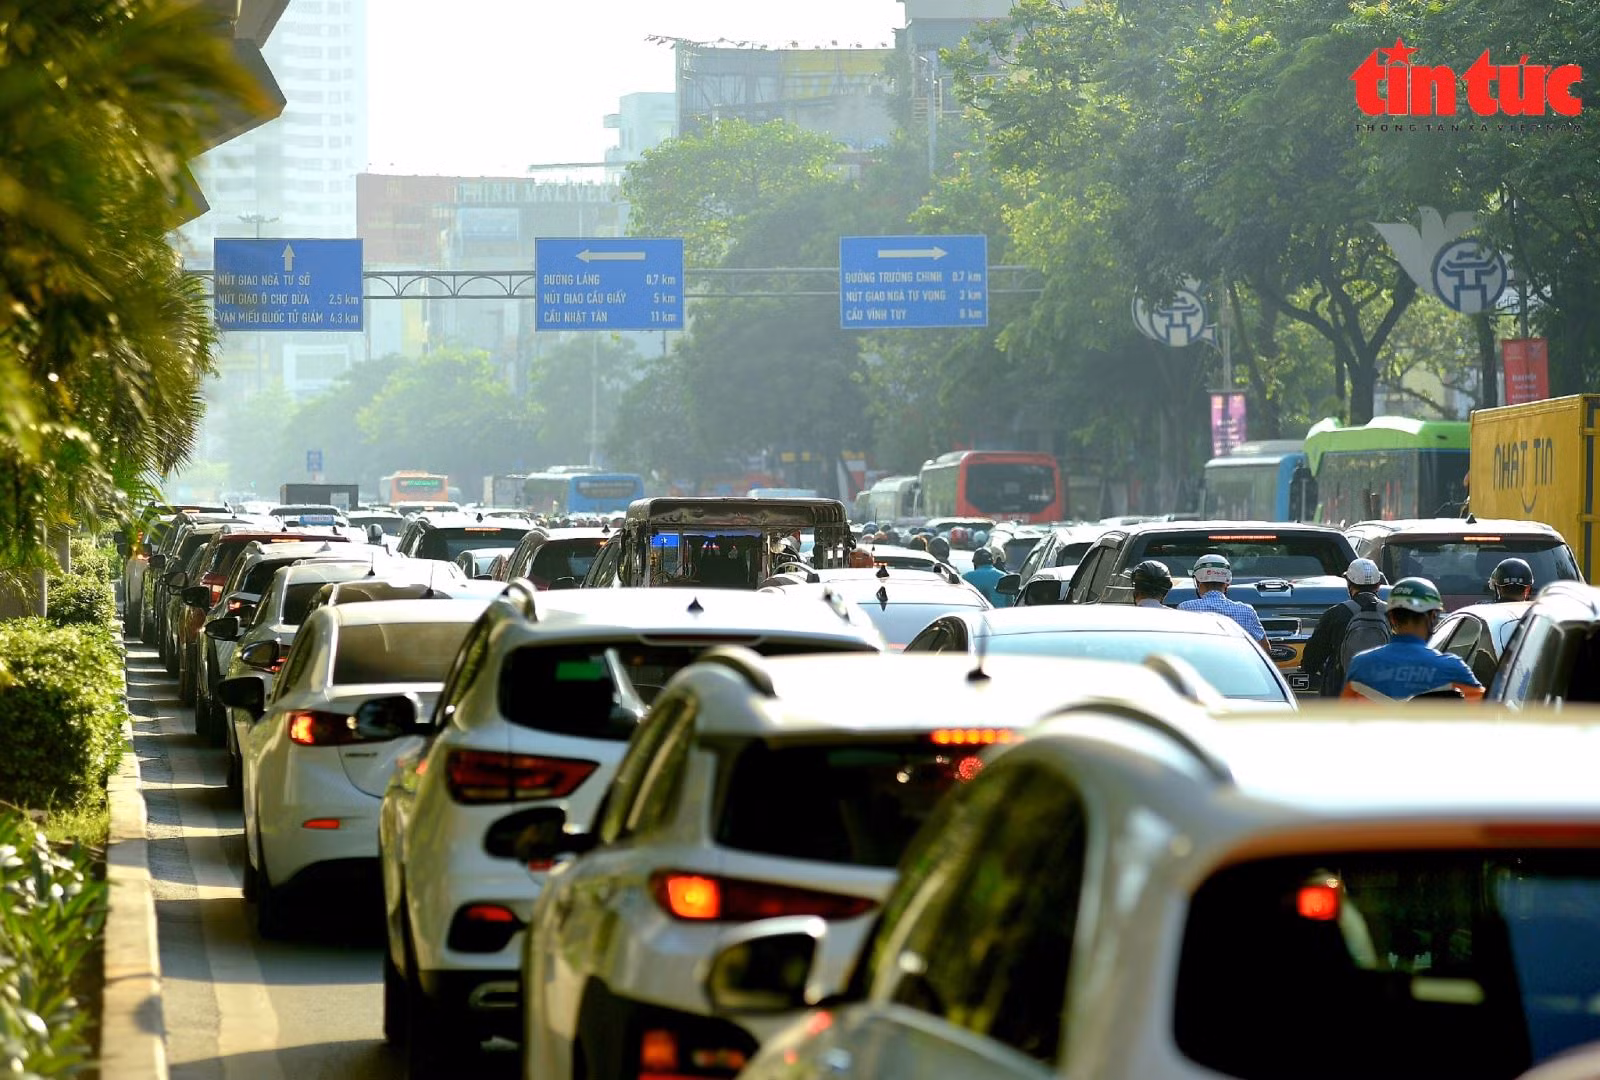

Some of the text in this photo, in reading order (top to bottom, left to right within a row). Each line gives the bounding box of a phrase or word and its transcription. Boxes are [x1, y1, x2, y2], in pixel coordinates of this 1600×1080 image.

[238, 274, 258, 285] GIAO
[576, 272, 600, 285] LÁNG
[662, 274, 676, 285] km
[968, 271, 982, 282] km
[238, 293, 258, 304] GIAO
[345, 294, 359, 304] km
[563, 293, 583, 304] GIAO
[653, 293, 659, 303] 5
[662, 293, 676, 304] km
[865, 291, 885, 302] GIAO
[968, 290, 982, 300] km
[345, 312, 359, 323] km
[651, 311, 659, 322] 11
[662, 311, 676, 322] km
[968, 308, 982, 319] km
[1395, 666, 1438, 682] GHN
